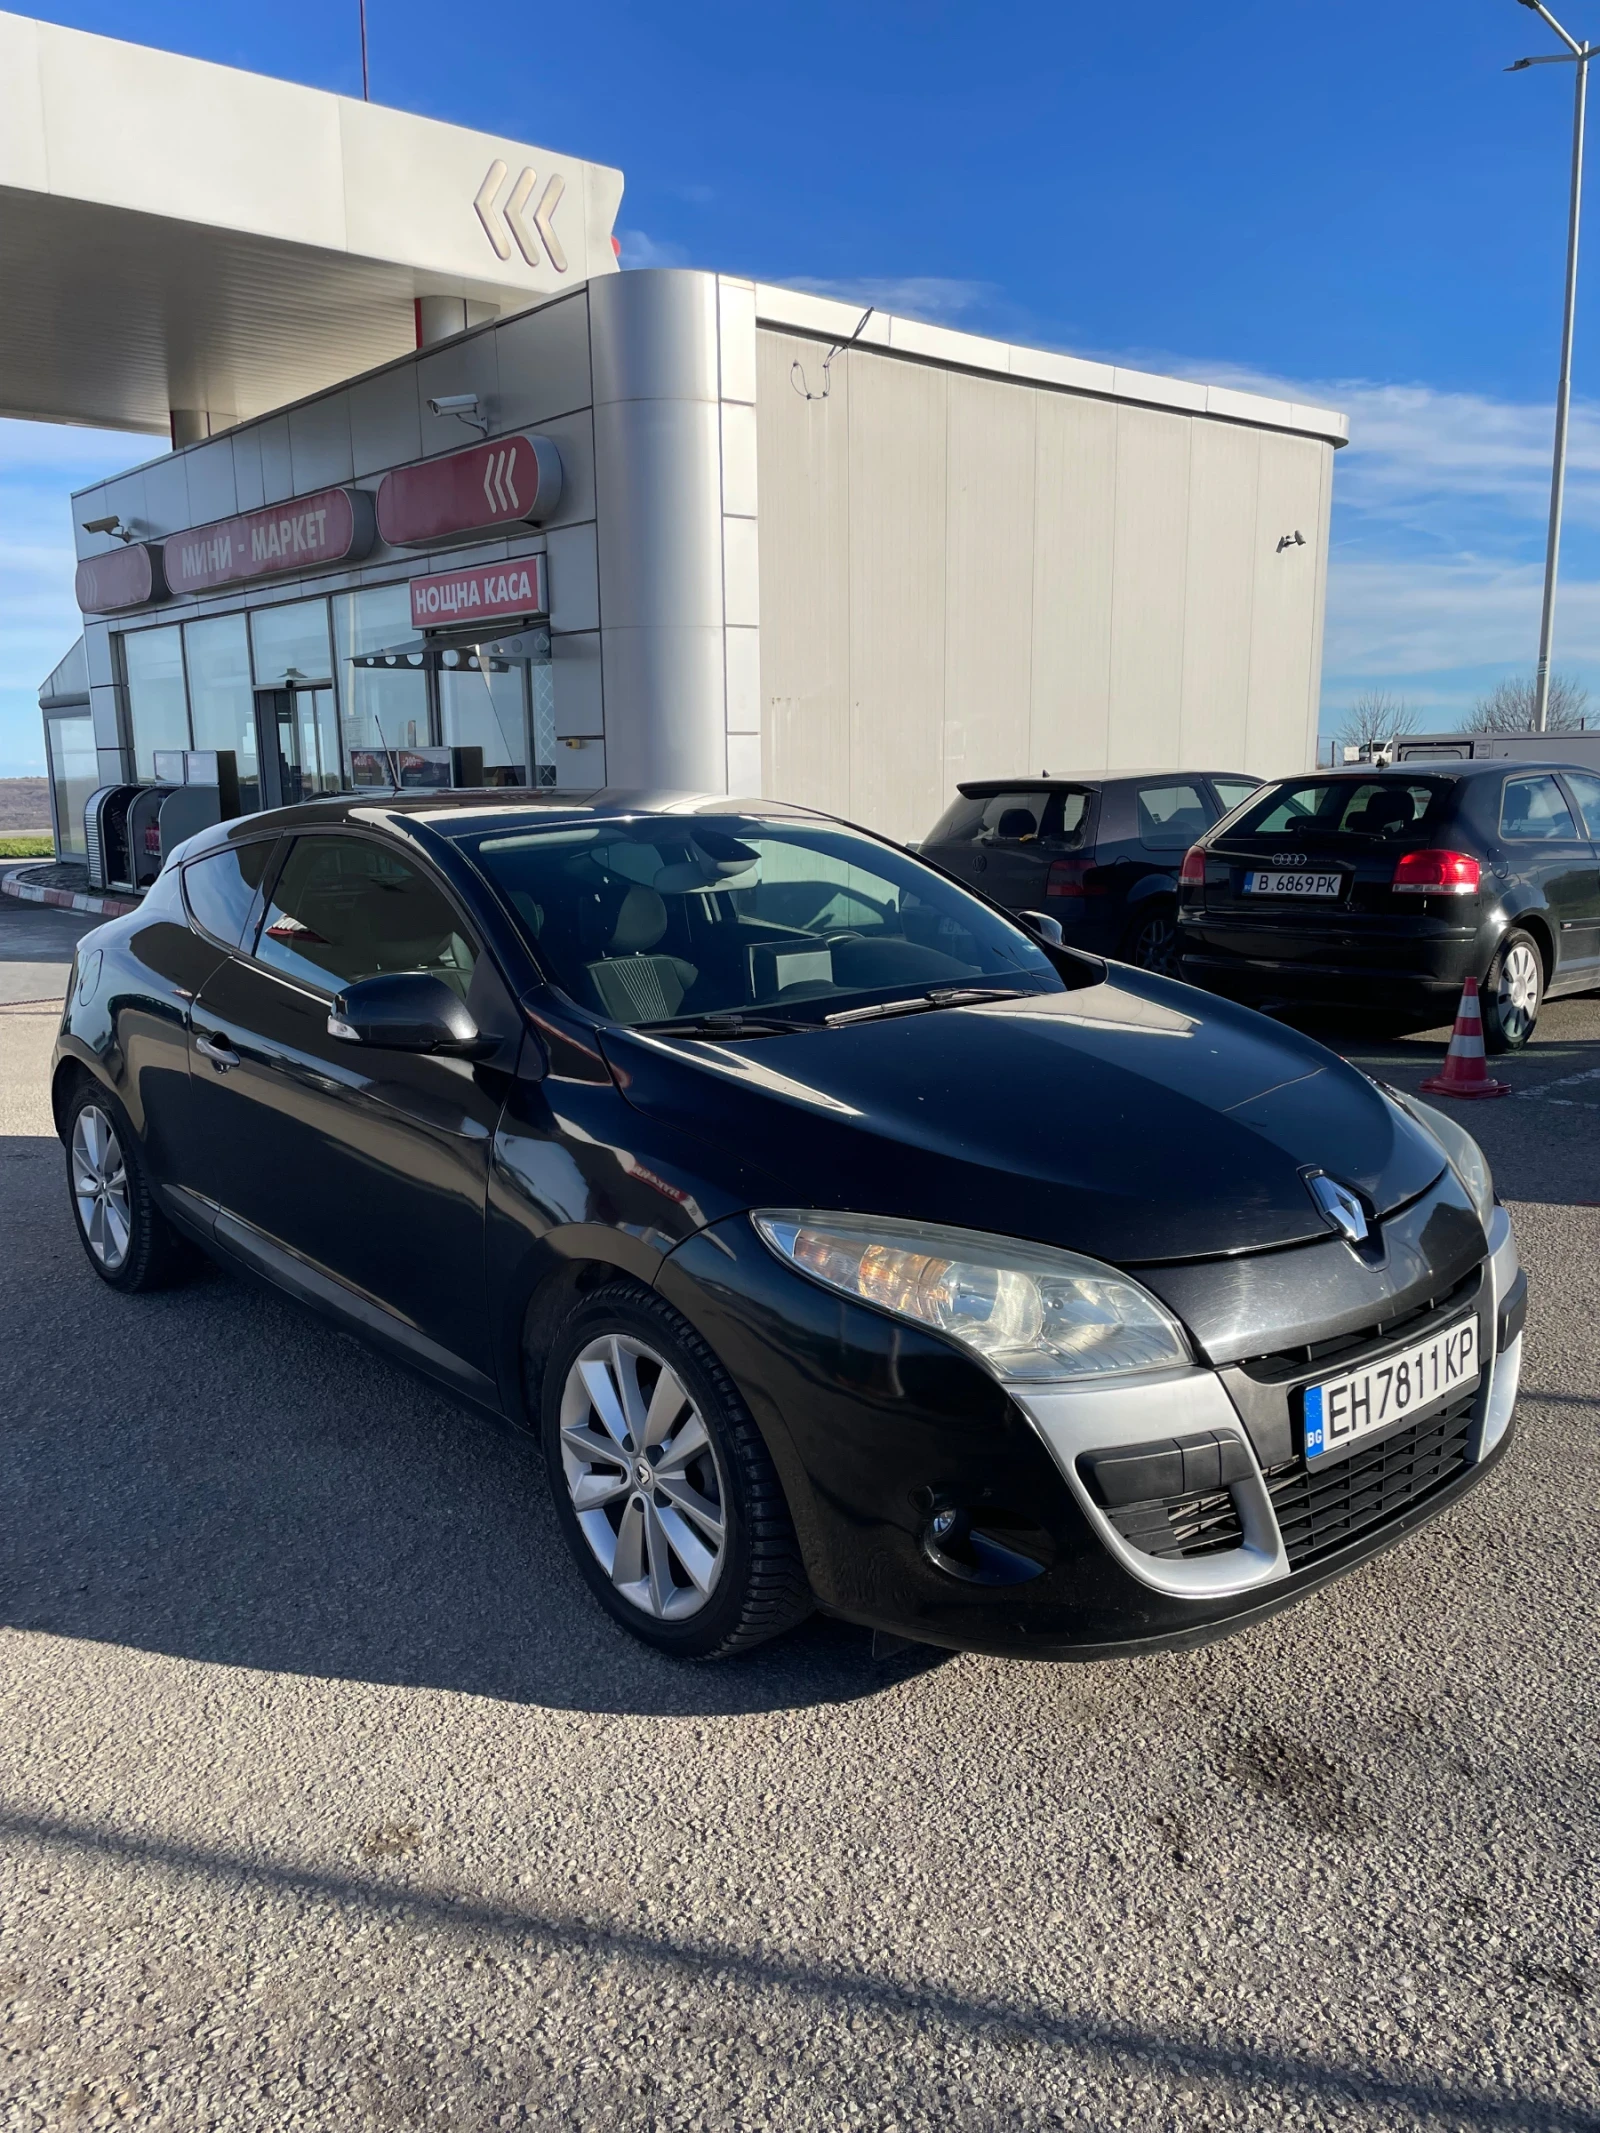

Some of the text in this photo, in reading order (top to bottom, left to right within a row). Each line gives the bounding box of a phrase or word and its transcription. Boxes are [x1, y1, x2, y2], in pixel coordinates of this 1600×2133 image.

[182, 536, 232, 579] МИНИ
[252, 509, 327, 562] МАРКЕТ
[415, 571, 532, 614] НОЩНА КАСА
[1307, 1326, 1473, 1448] BG EH7811KP
